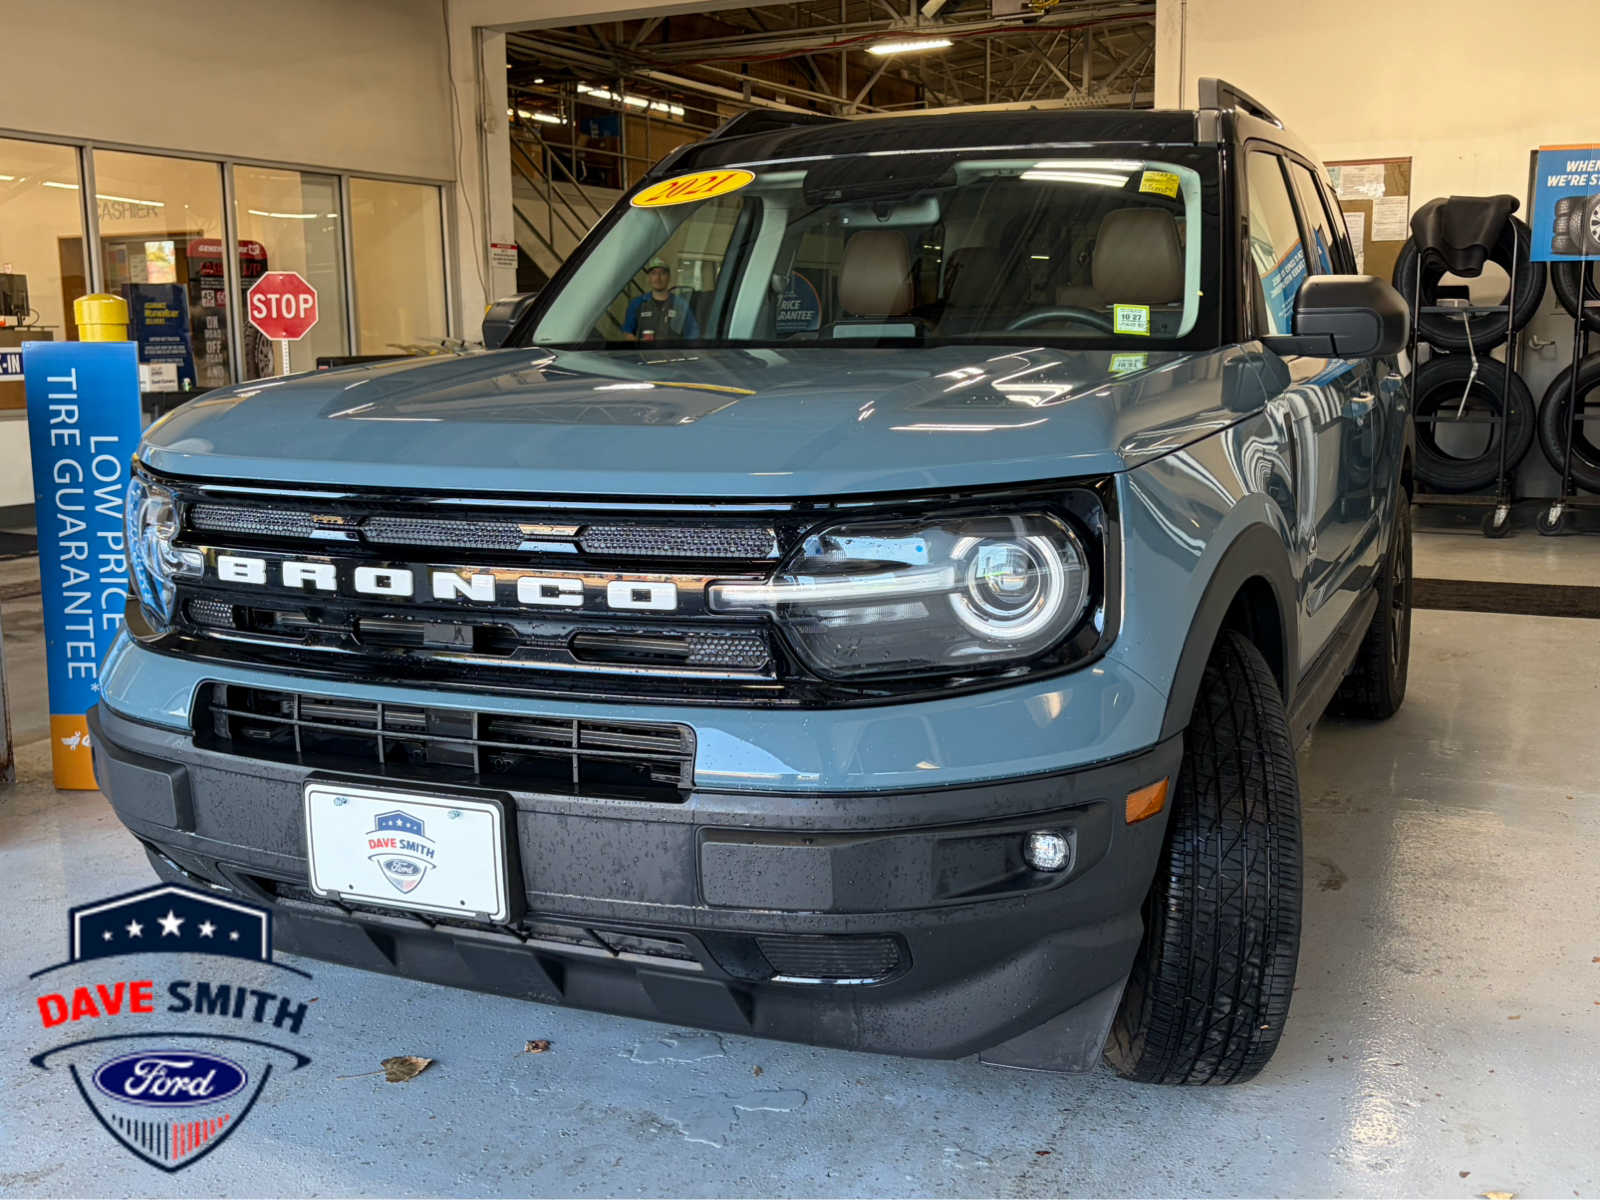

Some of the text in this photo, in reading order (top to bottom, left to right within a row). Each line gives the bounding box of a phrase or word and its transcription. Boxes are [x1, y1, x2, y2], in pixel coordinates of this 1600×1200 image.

[647, 173, 738, 201] 2021
[1547, 174, 1600, 187] WE'RE S
[97, 200, 158, 221] ASHIER
[252, 293, 314, 319] STOP
[0, 354, 21, 374] -IN
[47, 368, 80, 447] TIRE
[90, 436, 122, 519] LOW
[97, 531, 127, 631] PRICE
[217, 555, 677, 610] BRONCO
[368, 838, 434, 858] DAVE SMITH
[391, 860, 414, 874] Ford
